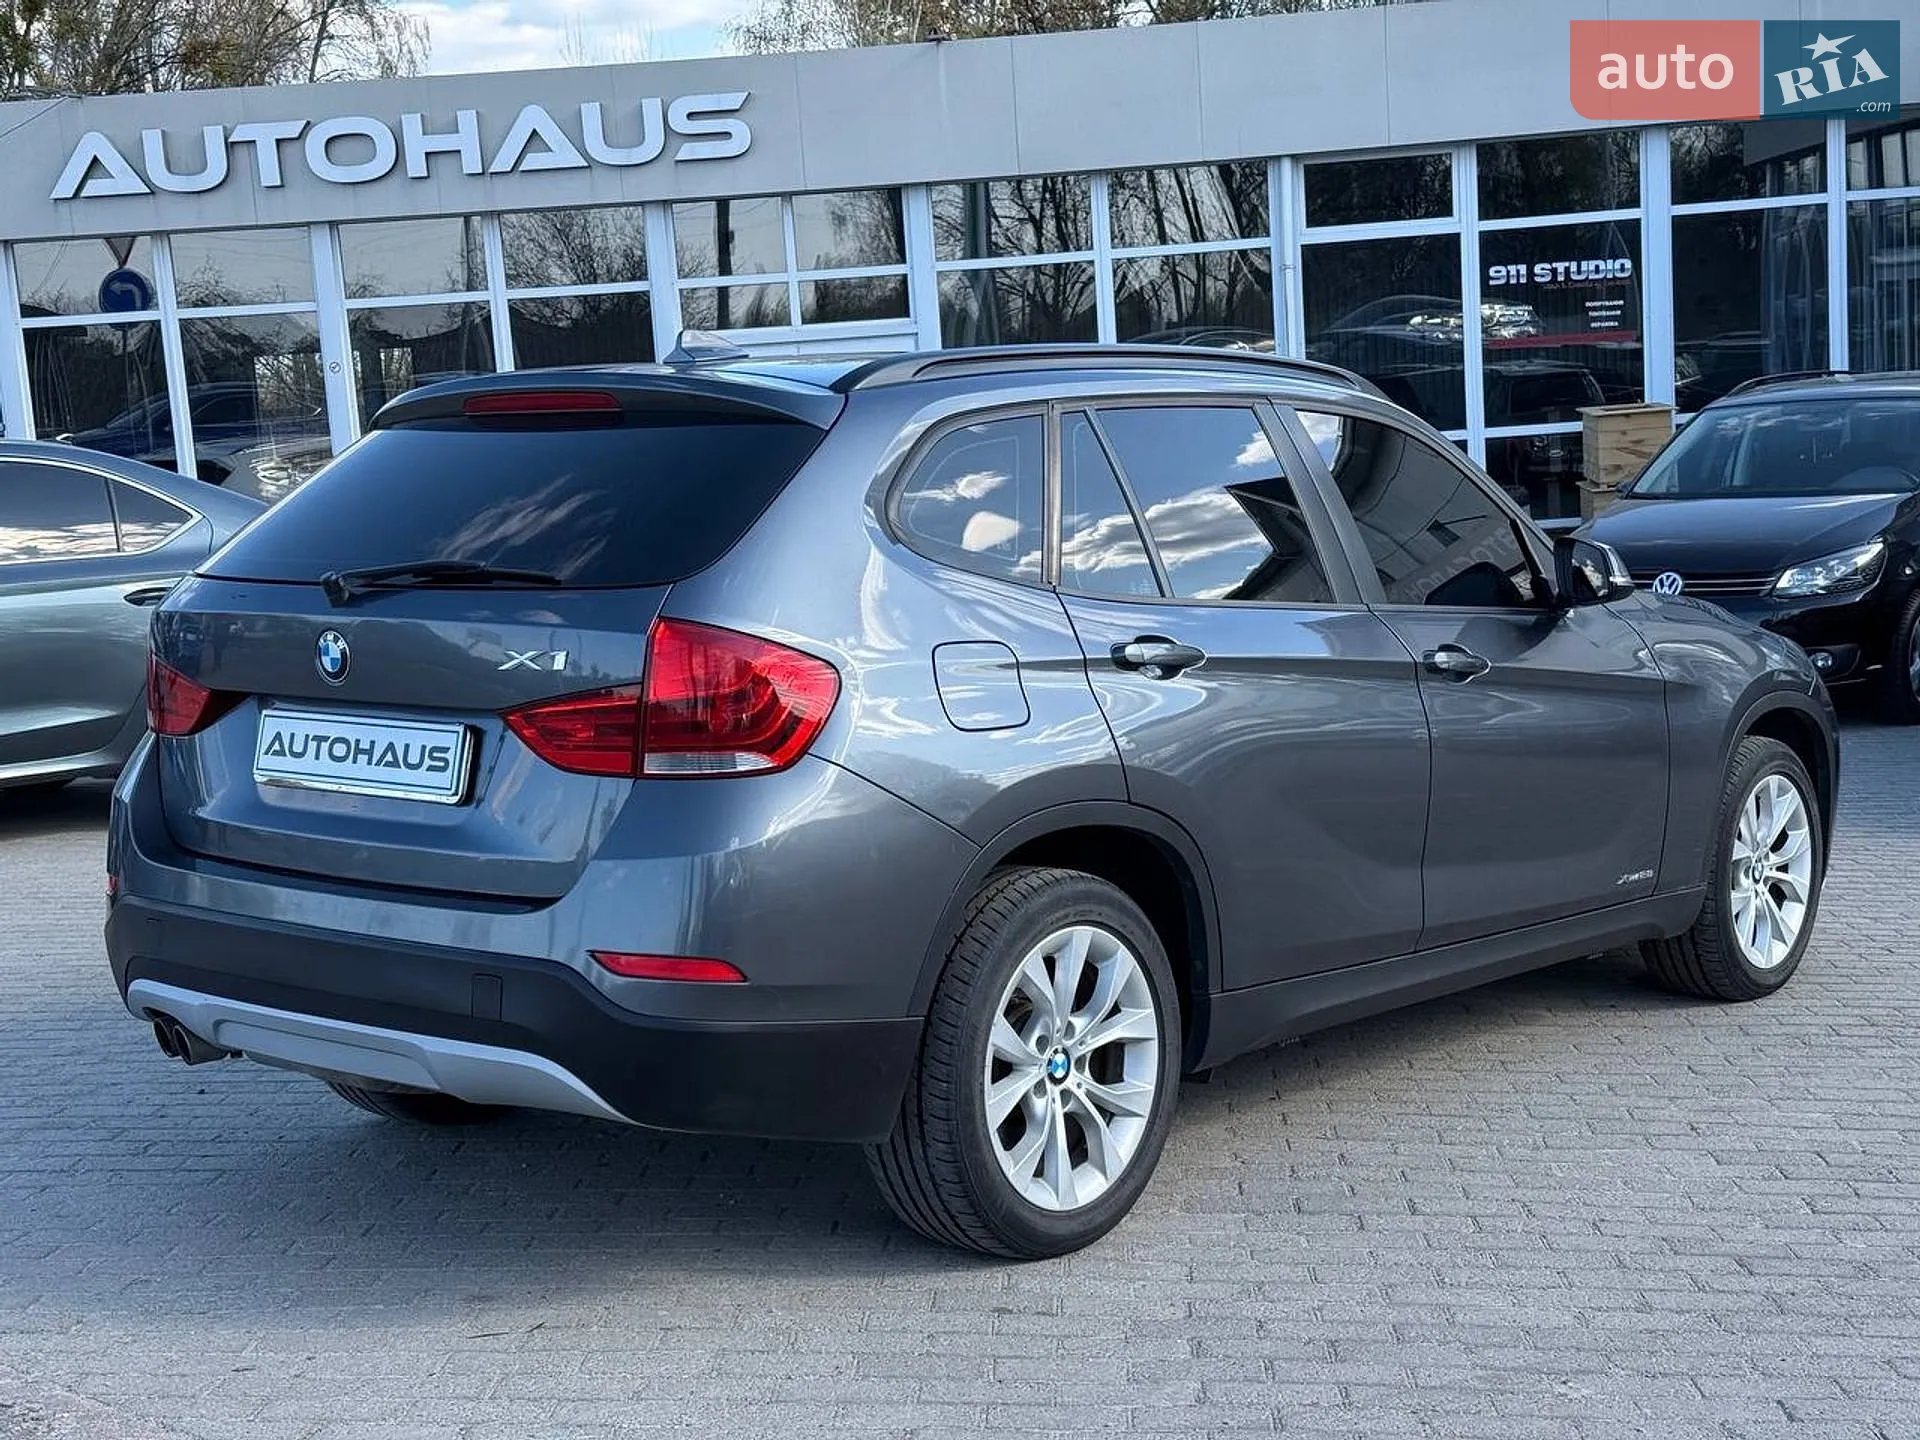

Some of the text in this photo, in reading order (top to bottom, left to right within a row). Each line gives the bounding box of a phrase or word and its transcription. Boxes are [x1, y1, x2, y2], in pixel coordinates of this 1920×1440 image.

[49, 91, 753, 201] AUTOHAUS
[1488, 263, 1527, 286] 911
[1533, 258, 1632, 283] STUDIO
[497, 650, 569, 671] X1
[263, 730, 452, 773] AUTOHAUS
